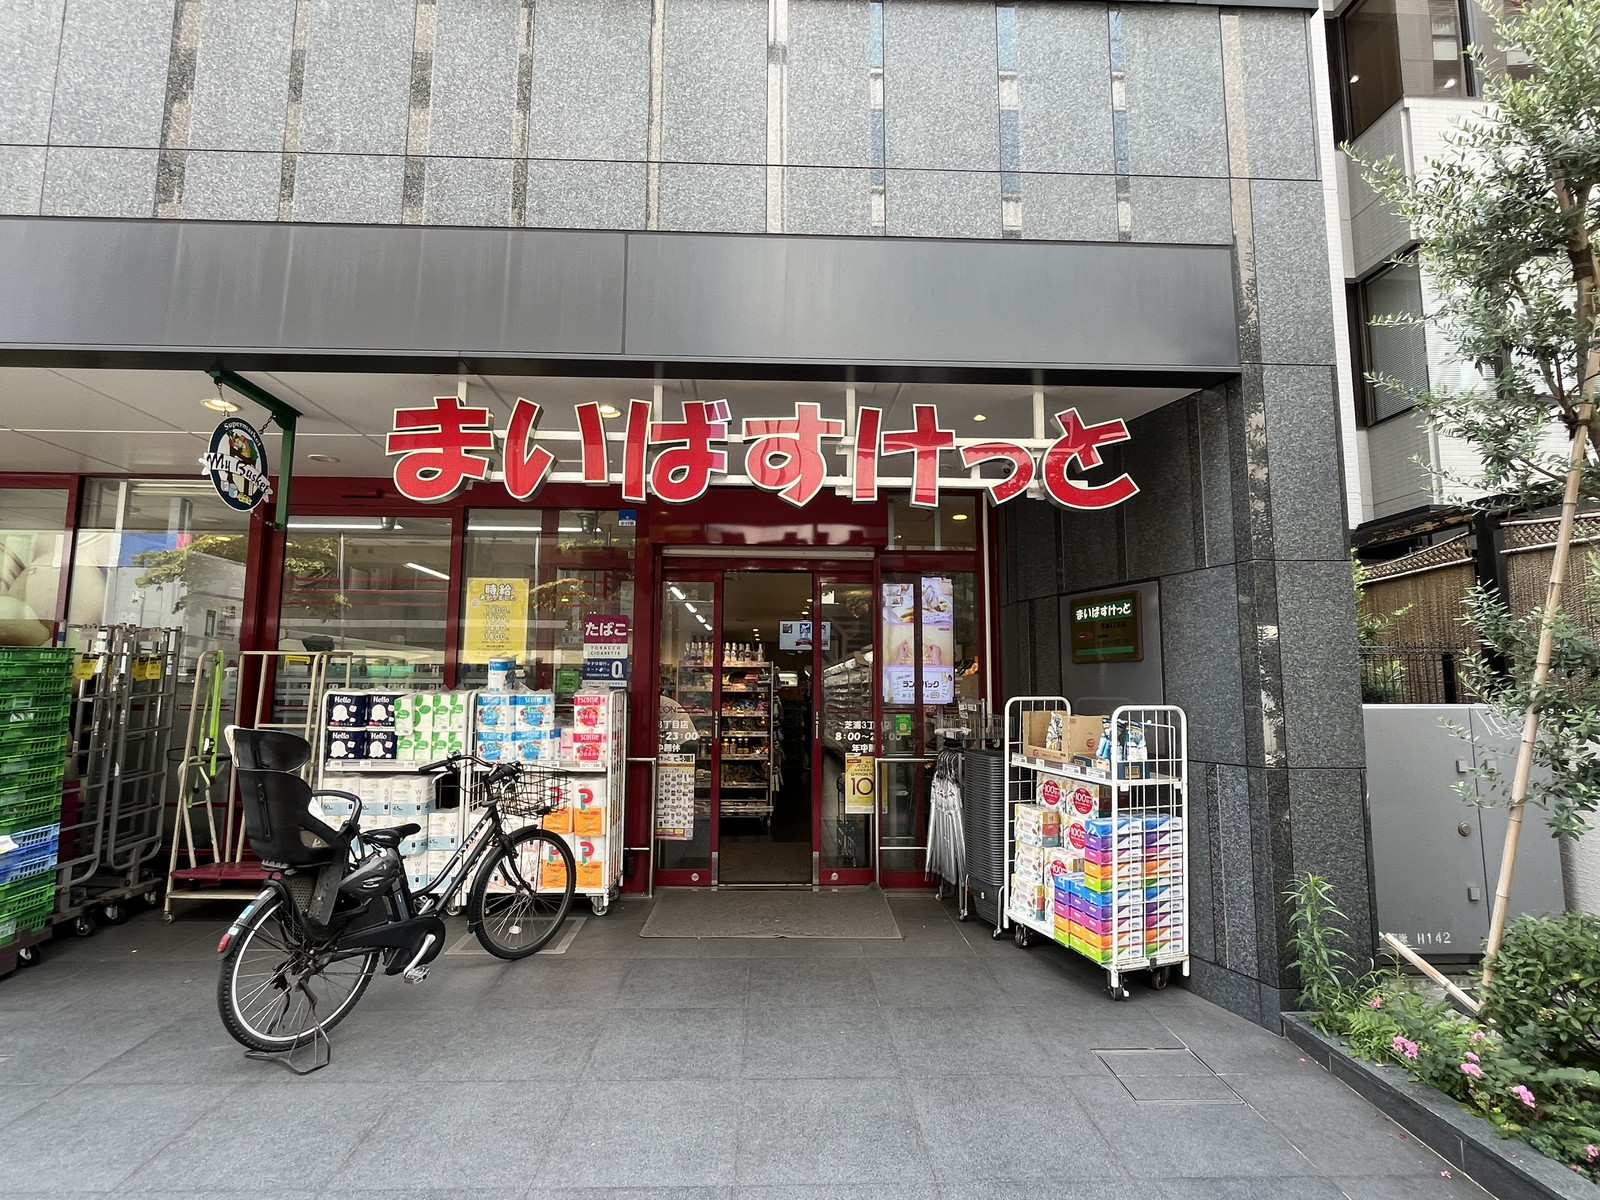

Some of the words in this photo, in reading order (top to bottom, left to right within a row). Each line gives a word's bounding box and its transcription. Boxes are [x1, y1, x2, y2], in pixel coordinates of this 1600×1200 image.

[223, 421, 261, 447] Supermarket
[386, 395, 1141, 510] まいばすけっと
[207, 453, 231, 473] My
[236, 460, 271, 493] Basket
[1075, 602, 1132, 621] まいばすけっと
[585, 621, 627, 637] たばこ
[334, 695, 352, 704] Hello
[373, 695, 390, 704] Hello
[332, 732, 350, 740] Hello
[370, 732, 388, 740] Hello
[1417, 931, 1452, 944] H142
